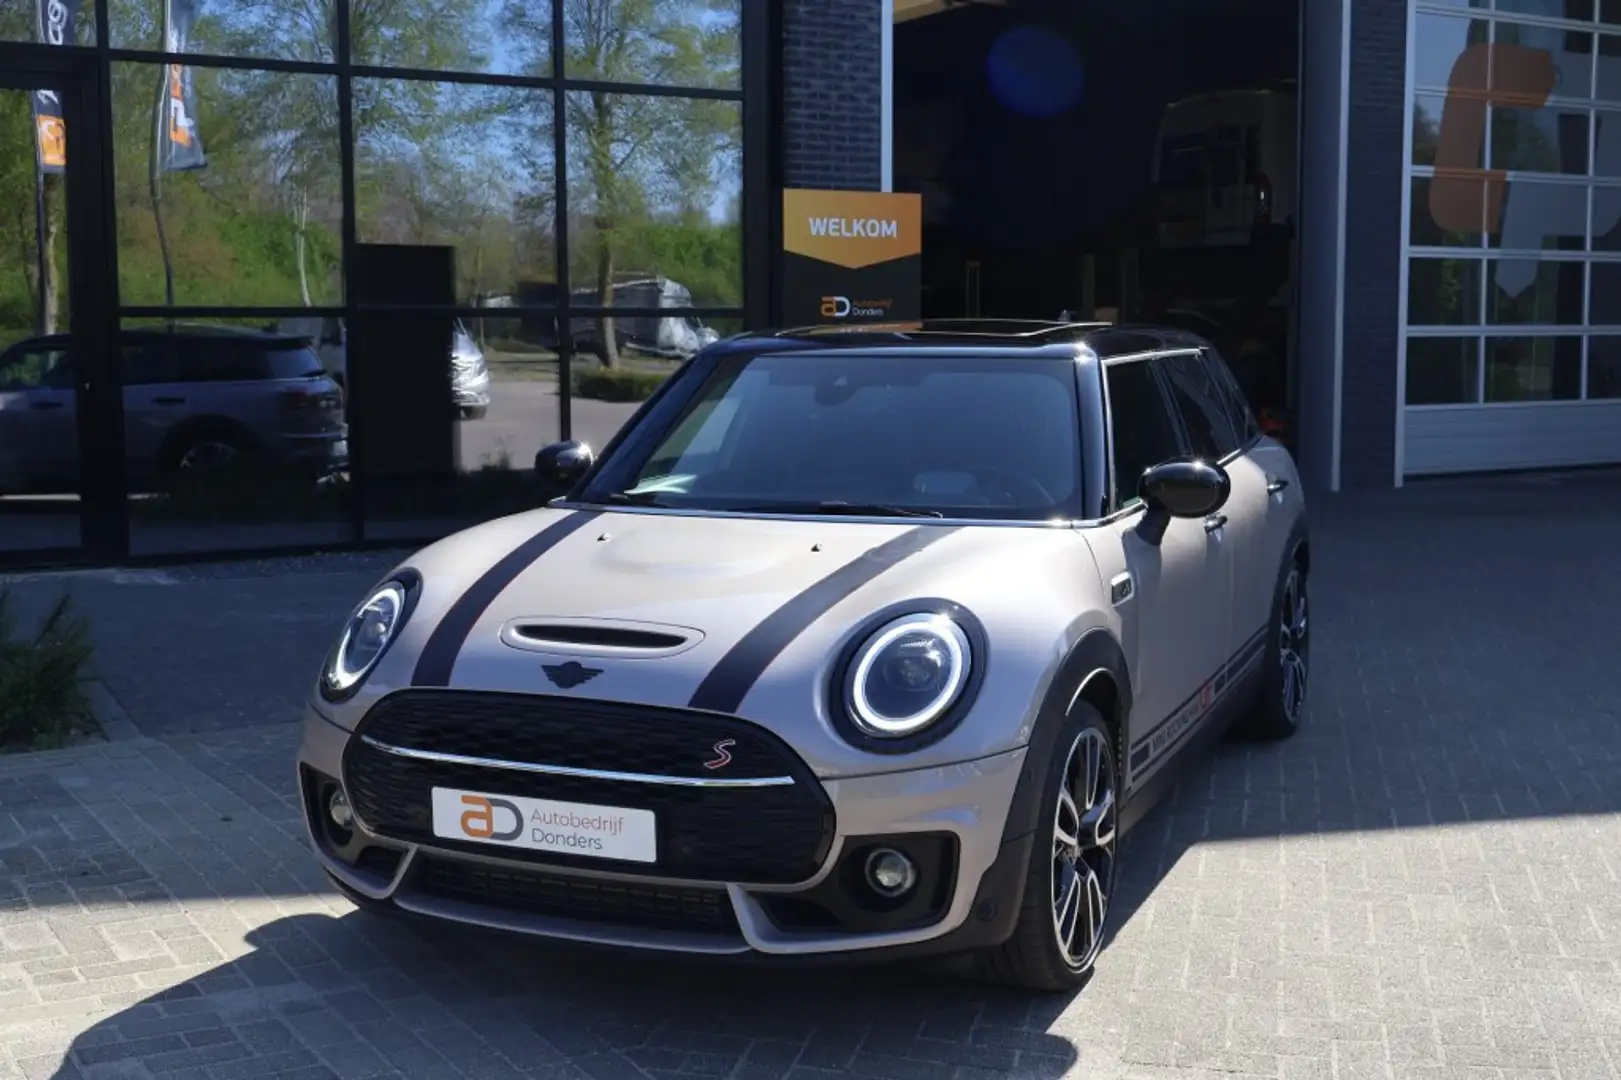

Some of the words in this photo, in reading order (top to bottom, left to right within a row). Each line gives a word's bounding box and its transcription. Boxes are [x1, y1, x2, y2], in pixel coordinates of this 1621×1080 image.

[808, 216, 898, 238] WELKOM
[852, 307, 884, 317] Donders
[704, 738, 736, 769] S
[529, 808, 625, 836] Autobedrijf
[531, 827, 603, 850] Donders
